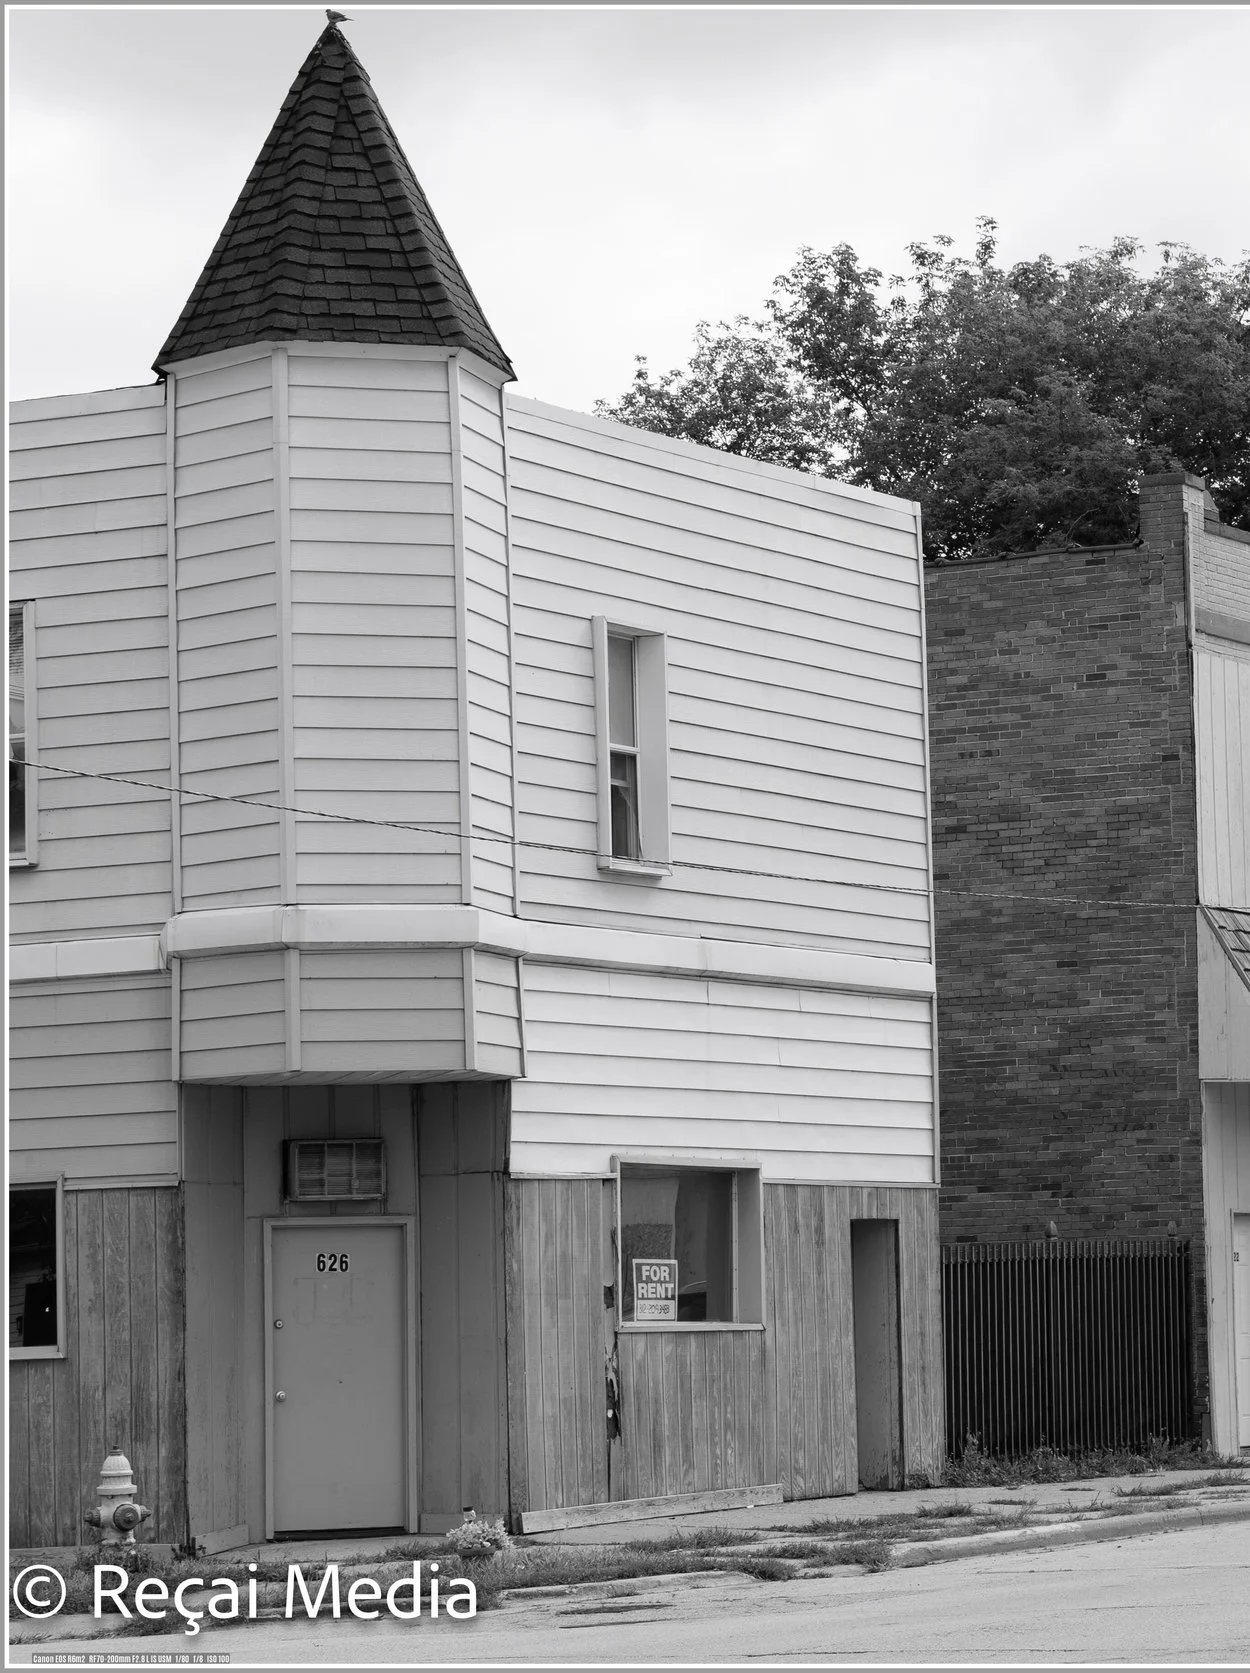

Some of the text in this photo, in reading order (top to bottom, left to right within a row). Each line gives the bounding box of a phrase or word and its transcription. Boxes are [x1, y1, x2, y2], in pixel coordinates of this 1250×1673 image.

[317, 1253, 349, 1272] 626
[641, 1265, 670, 1281] FOR
[637, 1282, 675, 1298] RENT
